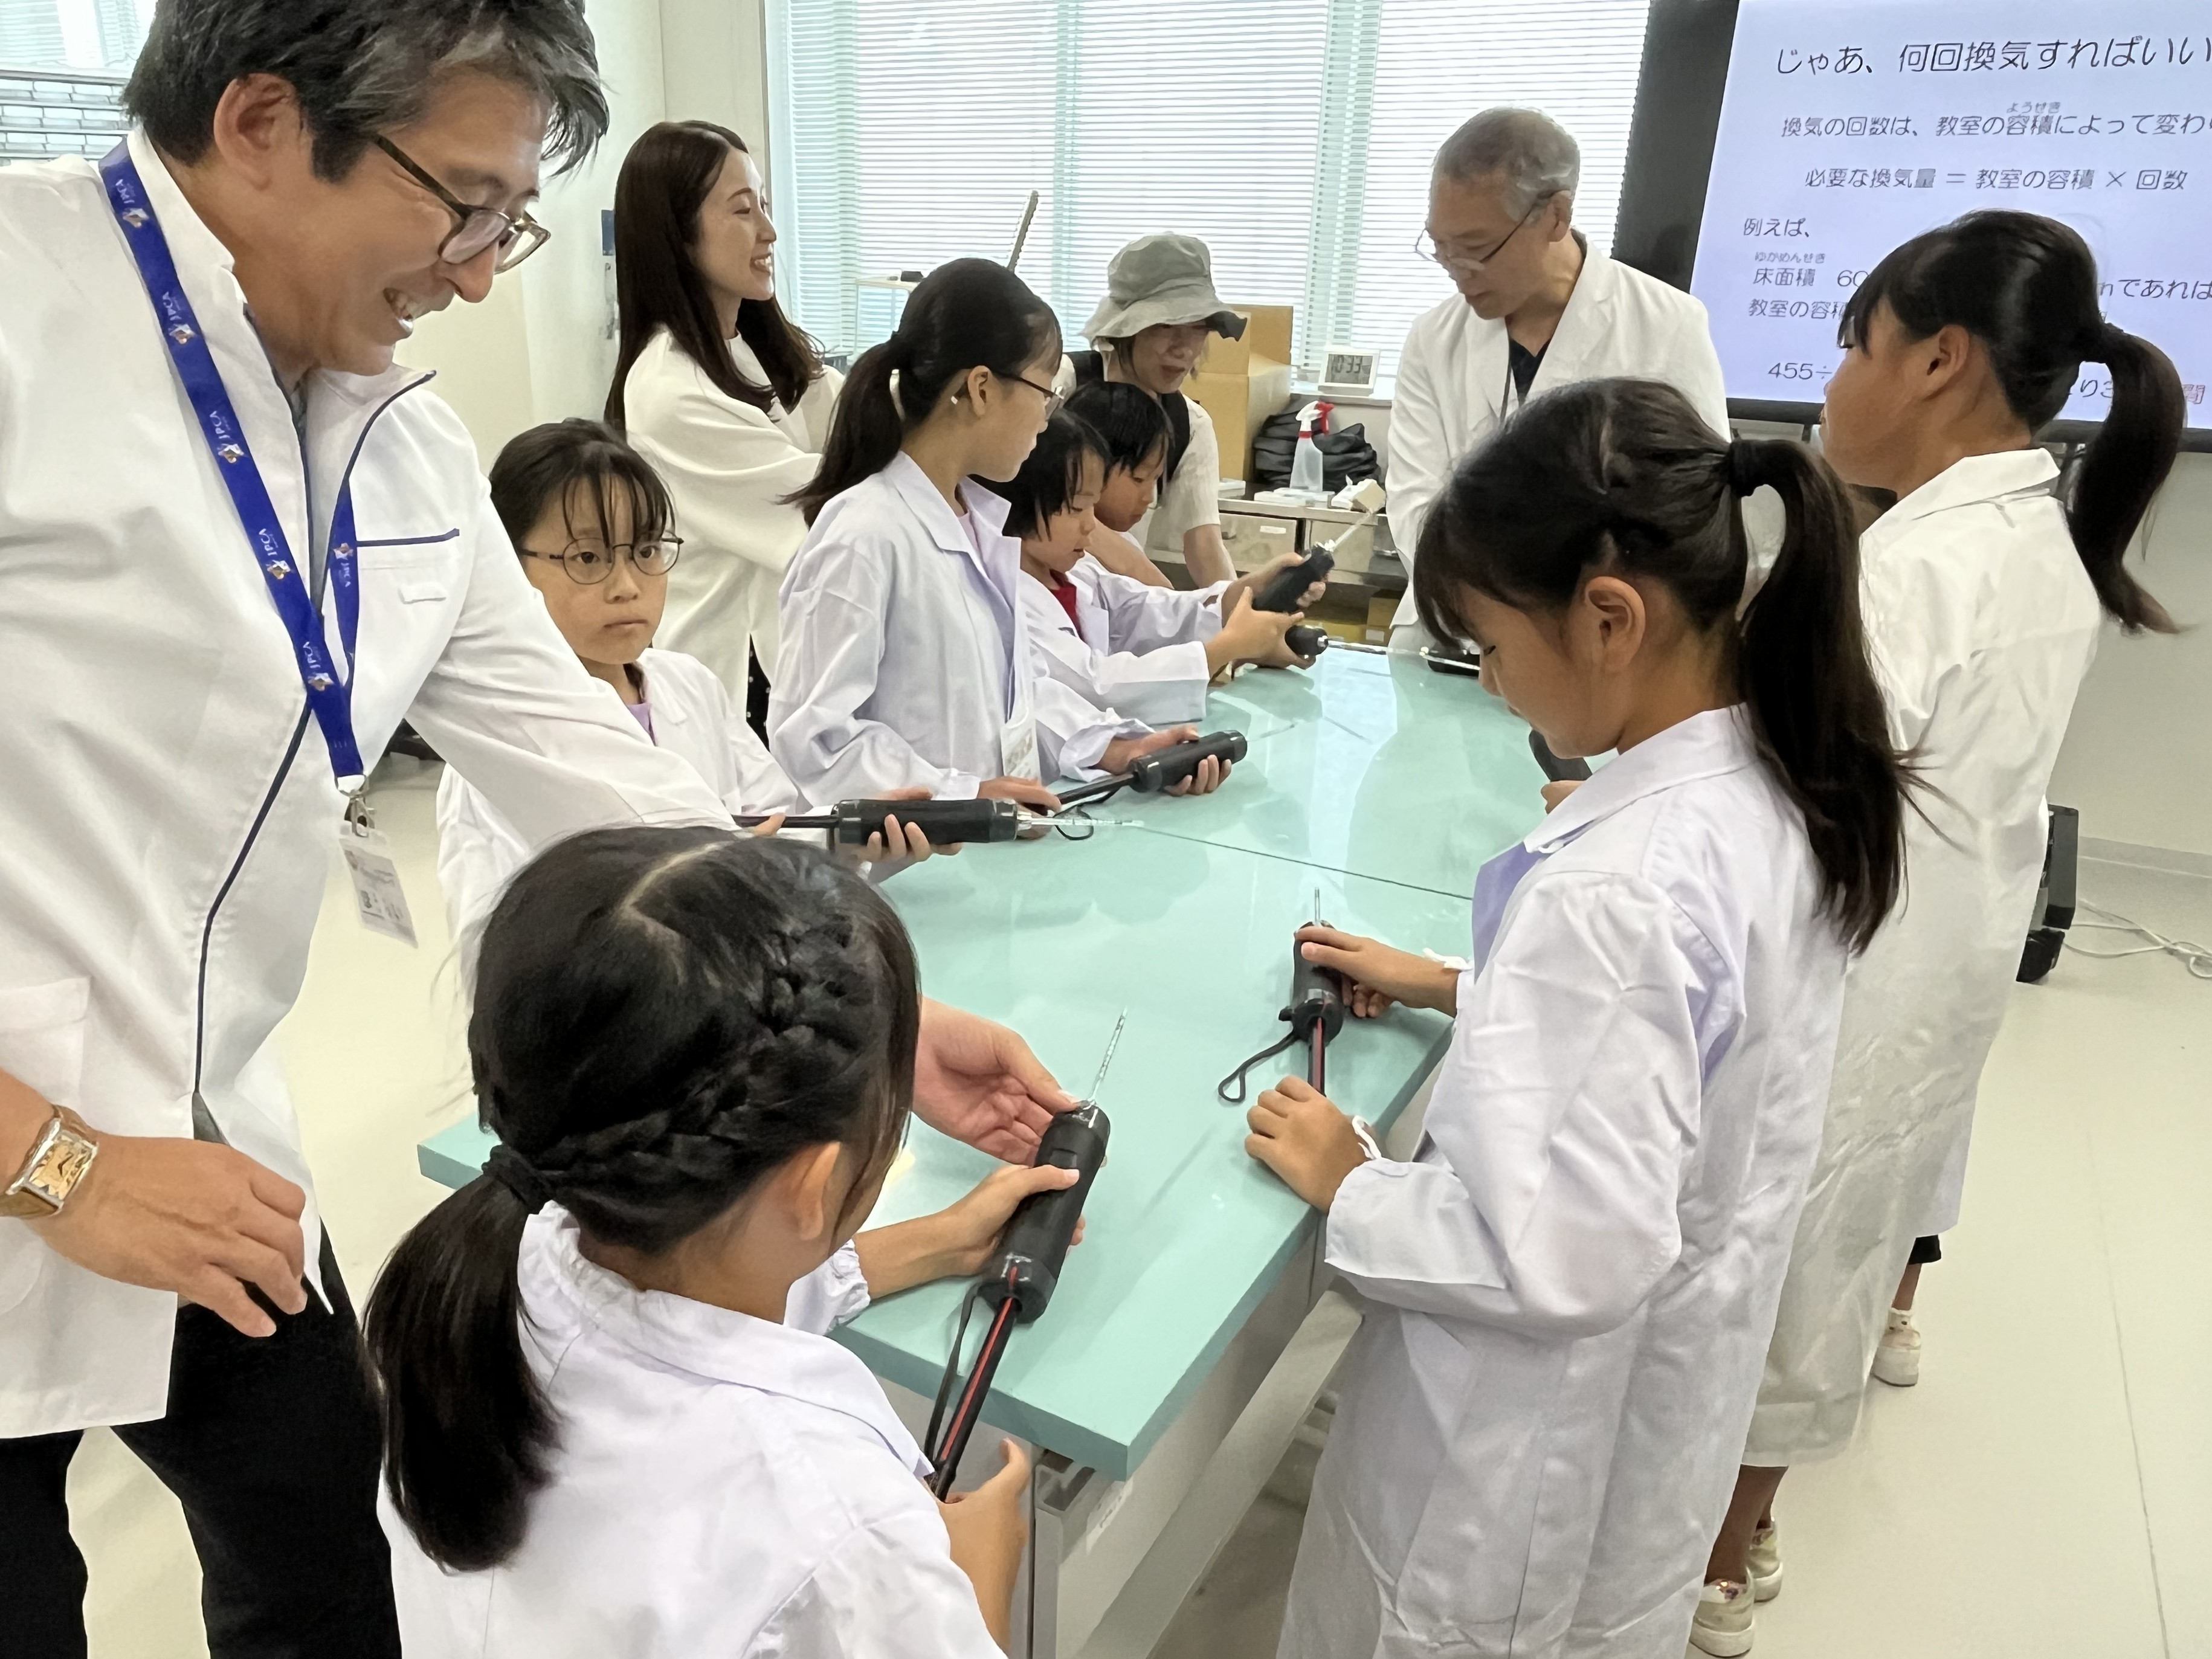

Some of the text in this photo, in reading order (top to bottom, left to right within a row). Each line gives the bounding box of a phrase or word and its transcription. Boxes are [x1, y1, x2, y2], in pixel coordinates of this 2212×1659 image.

[1781, 113, 2212, 137] 換気の回数は、教室の容積によって変わ
[1975, 169, 2095, 190] 教室の容積
[2136, 169, 2188, 190] 回数
[1752, 267, 1816, 287] 床面積
[258, 527, 278, 556] JPCA
